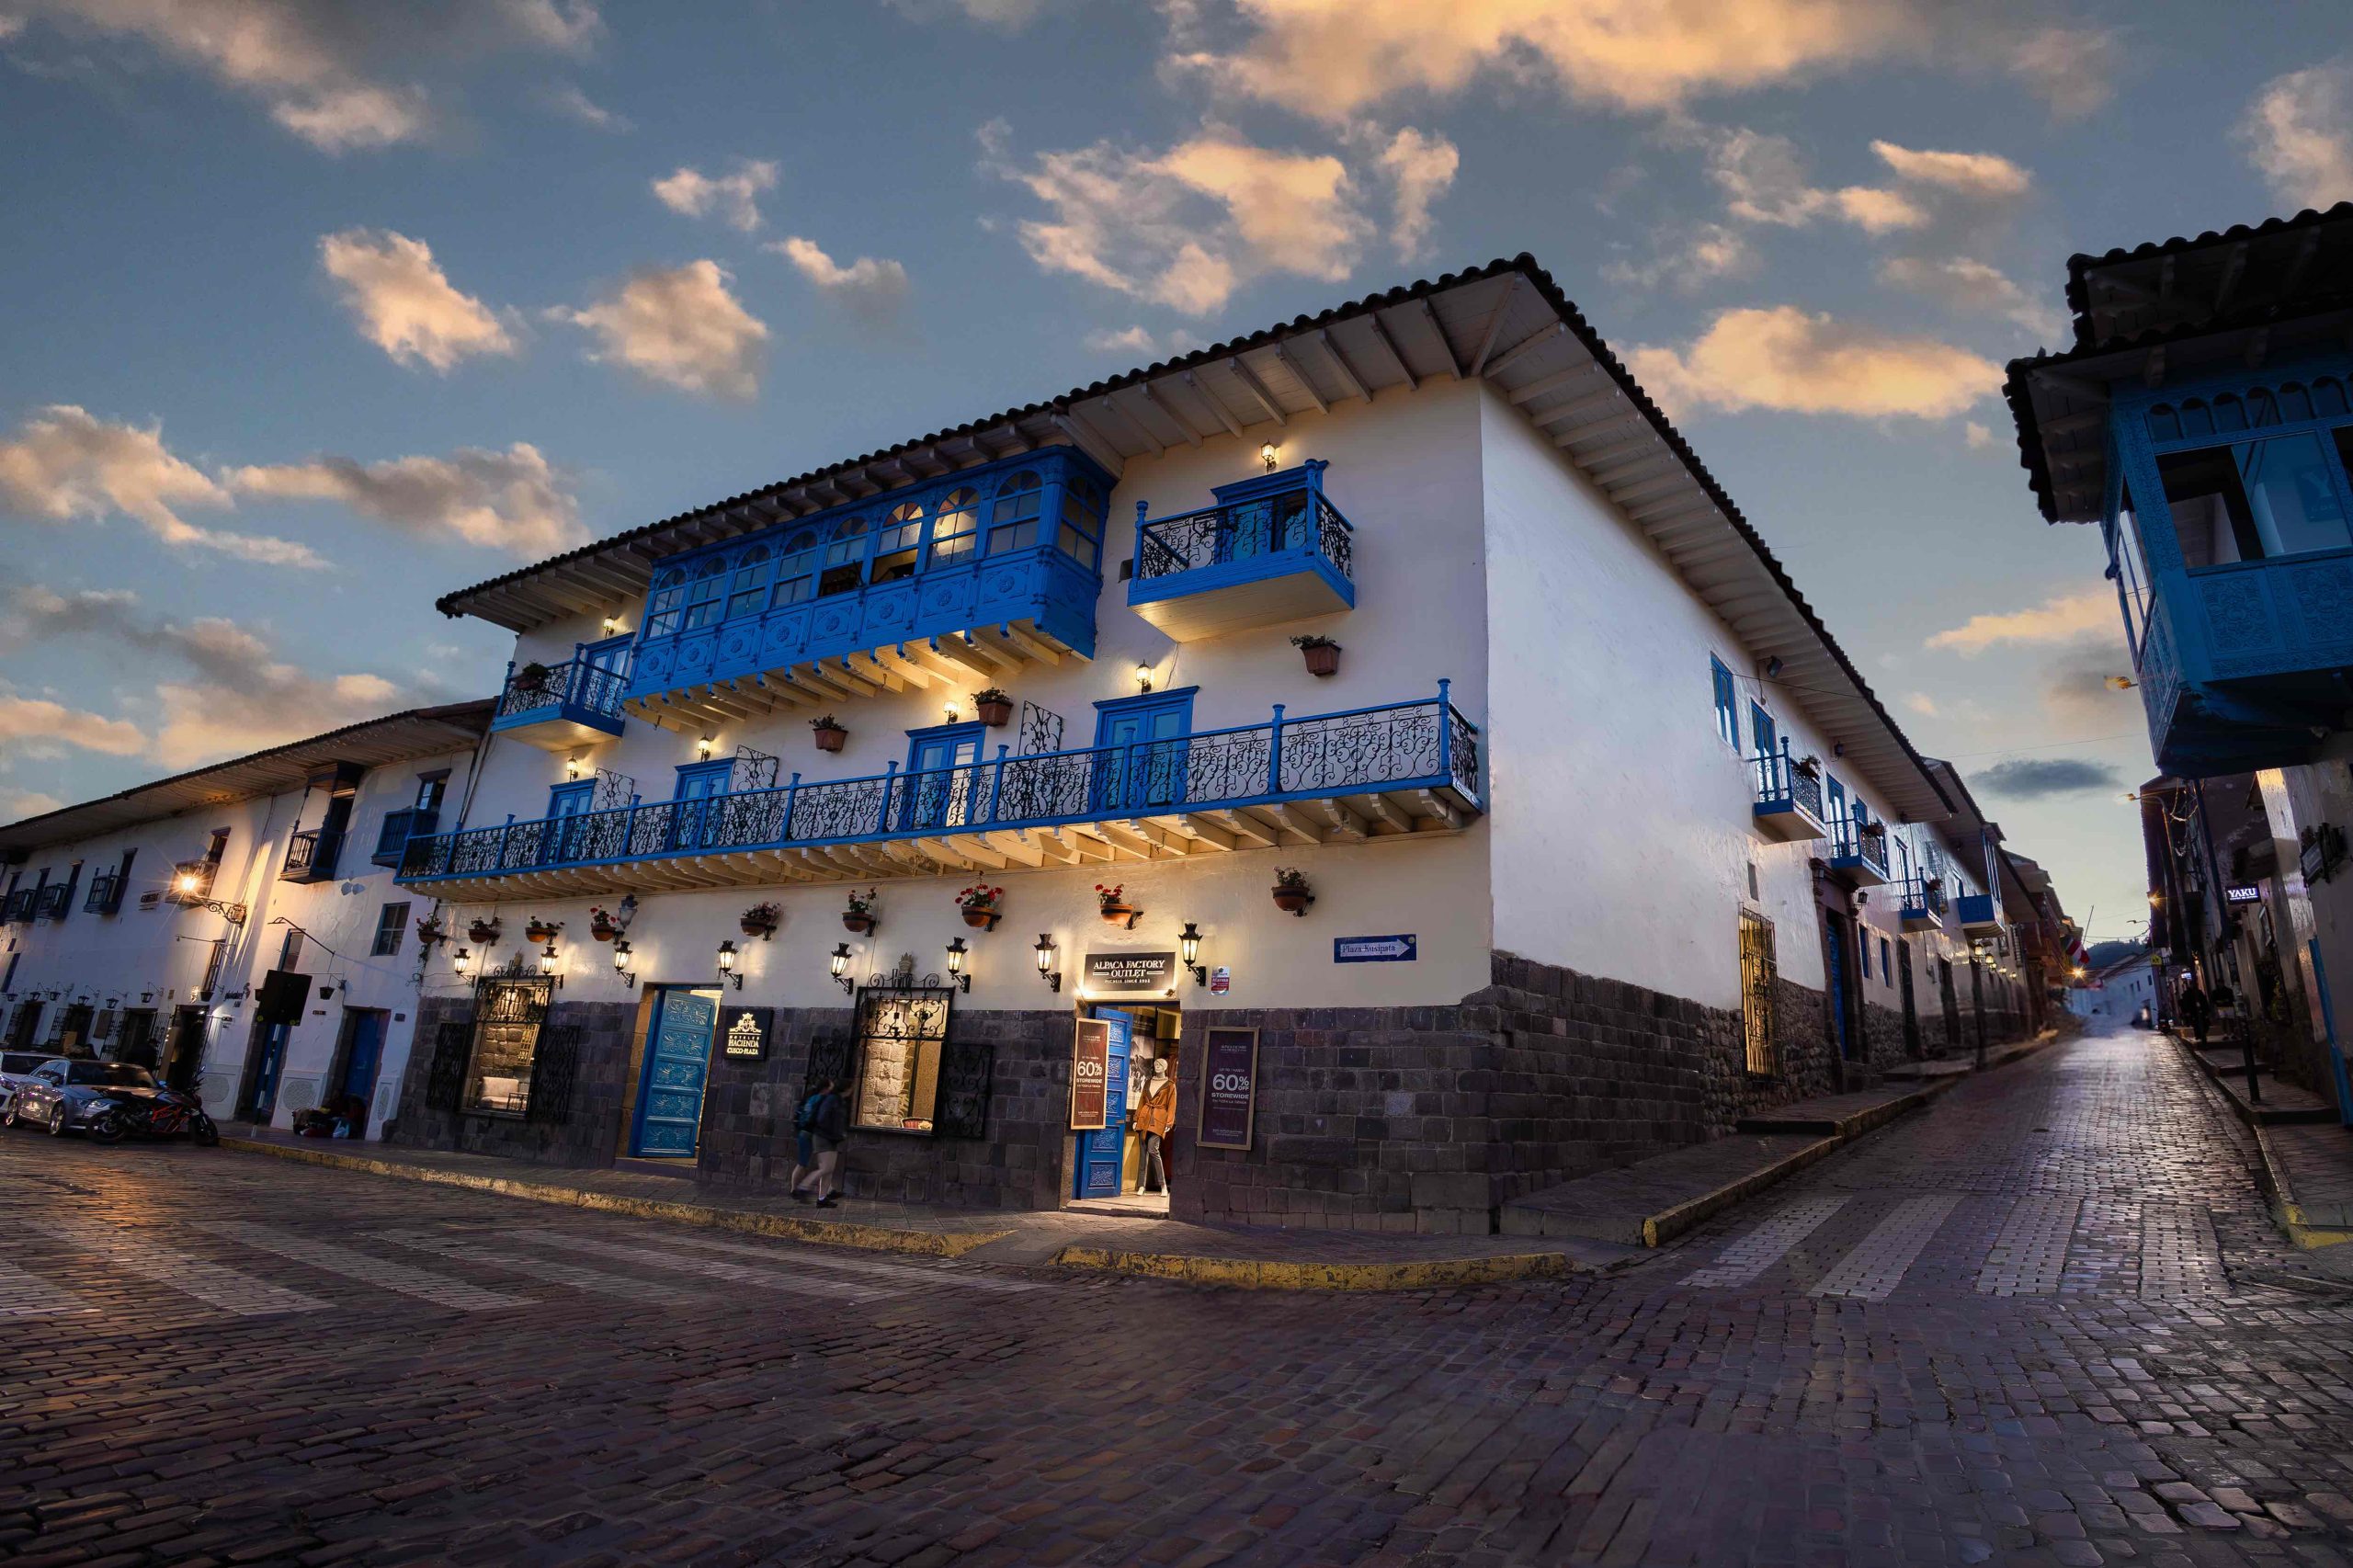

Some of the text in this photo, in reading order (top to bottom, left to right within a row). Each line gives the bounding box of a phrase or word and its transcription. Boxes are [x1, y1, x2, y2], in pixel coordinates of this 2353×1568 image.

[2227, 887, 2256, 898] YAKU
[1343, 943, 1395, 954] Plaza Kusipata
[1093, 960, 1165, 970] ALPACA FACTORY
[1110, 969, 1146, 978] OUTLET
[728, 1040, 759, 1048] HACIENDA
[1211, 1092, 1250, 1100] STOREWIDE
